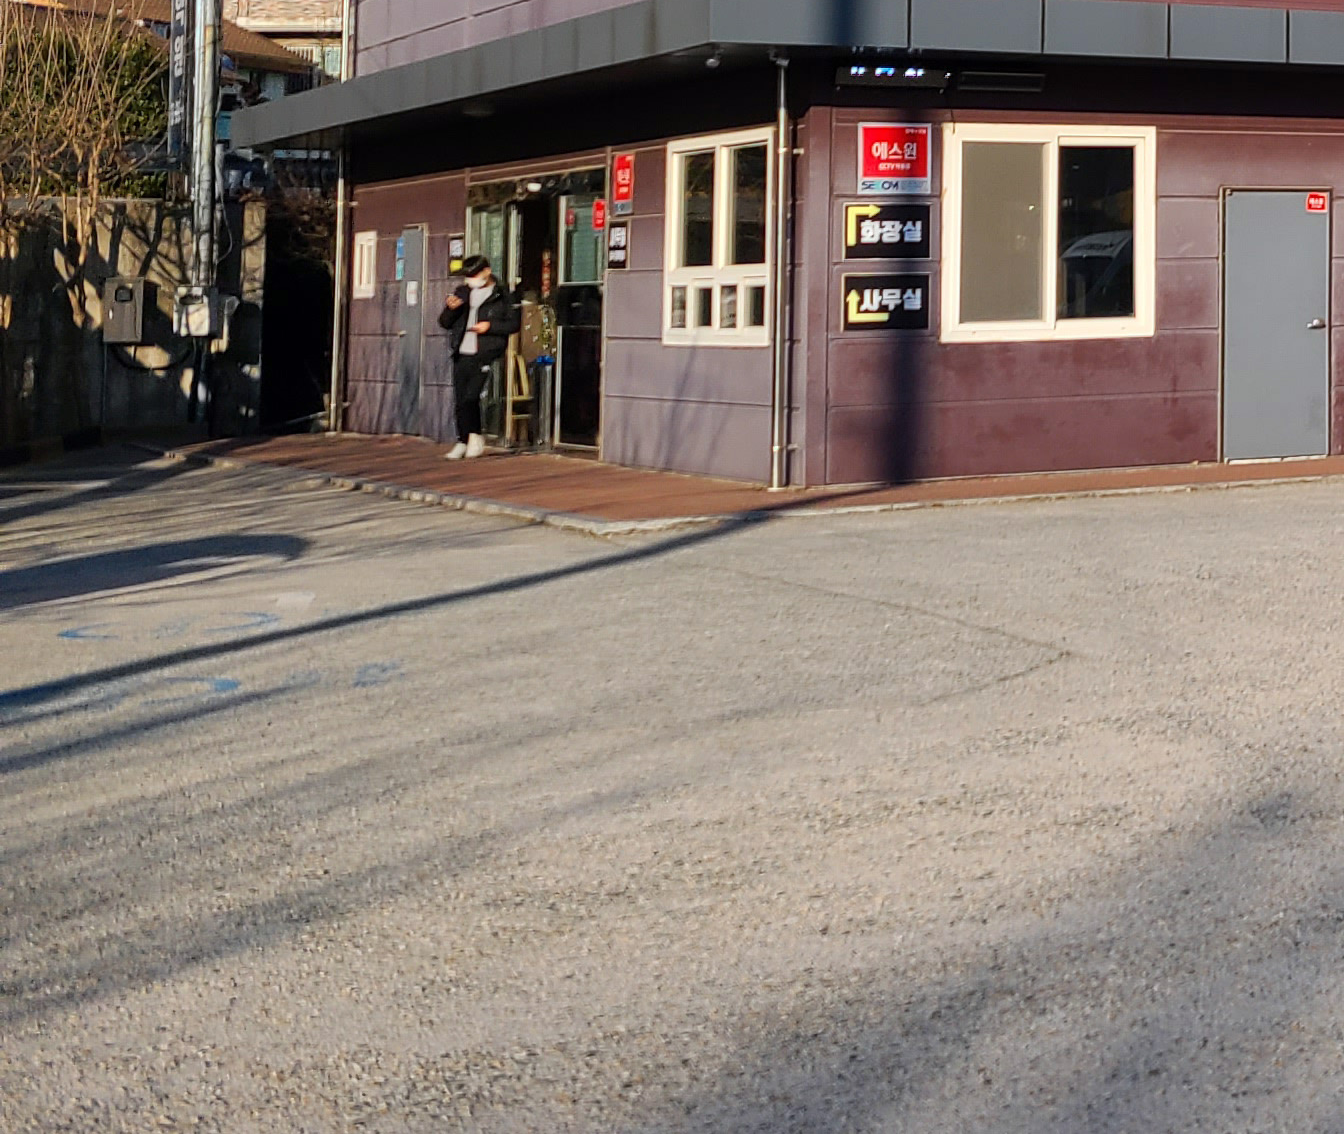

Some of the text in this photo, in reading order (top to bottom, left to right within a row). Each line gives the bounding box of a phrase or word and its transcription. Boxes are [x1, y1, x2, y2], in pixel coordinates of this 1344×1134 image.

[871, 141, 917, 160] 에스원
[860, 219, 922, 244] 화장실
[859, 288, 922, 311] 사무실
